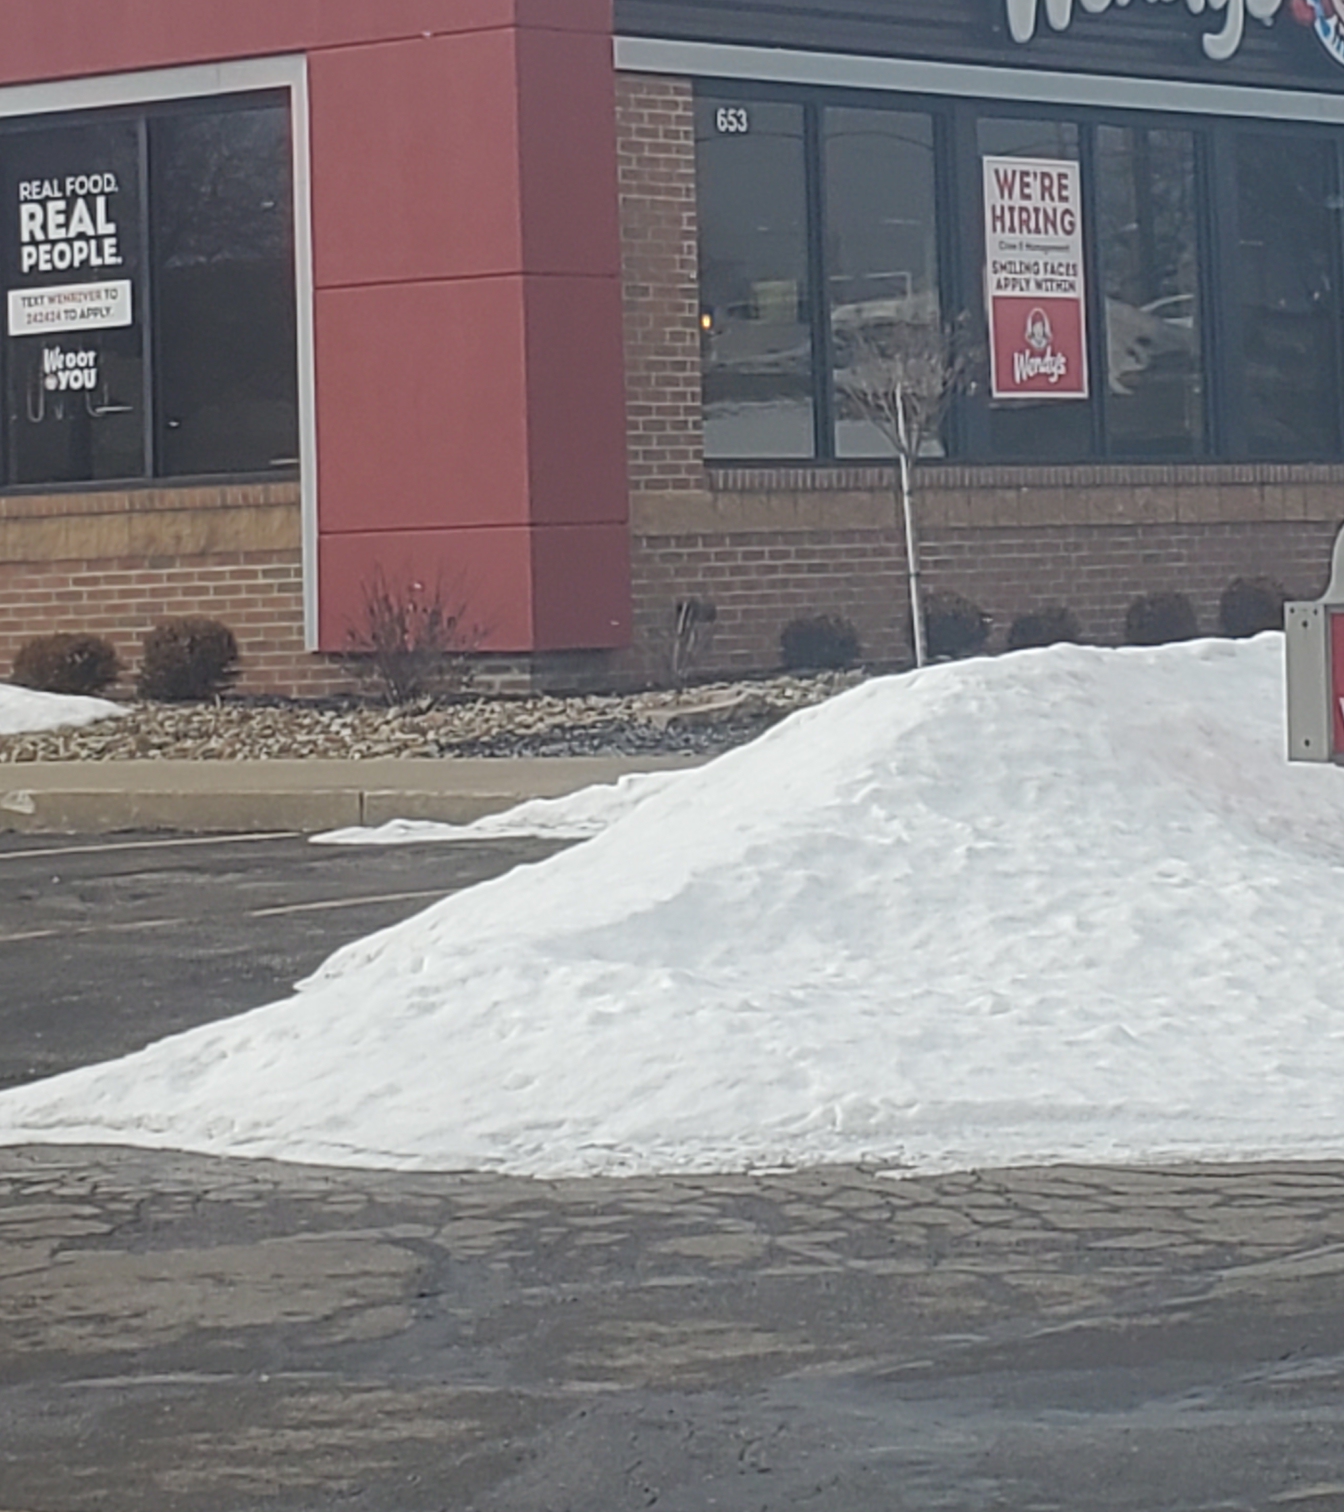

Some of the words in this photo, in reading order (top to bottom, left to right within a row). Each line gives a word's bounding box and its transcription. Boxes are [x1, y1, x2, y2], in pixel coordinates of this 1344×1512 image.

[716, 107, 748, 133] 653
[19, 178, 63, 202] REAL
[65, 173, 119, 198] FOOD.
[994, 168, 1069, 203] WE'RE
[19, 196, 117, 242] REAL
[991, 204, 1076, 237] HIRING
[21, 237, 122, 273] PEOPLE.
[992, 260, 1040, 275] SMILING
[1043, 261, 1078, 277] FACES
[21, 294, 45, 308] TEXT
[104, 288, 119, 300] TO
[995, 277, 1030, 292] APPLY
[1034, 278, 1076, 292] WITHIN
[63, 308, 77, 321] TO
[1013, 346, 1067, 384] Wendy's
[57, 368, 97, 391] YOU
